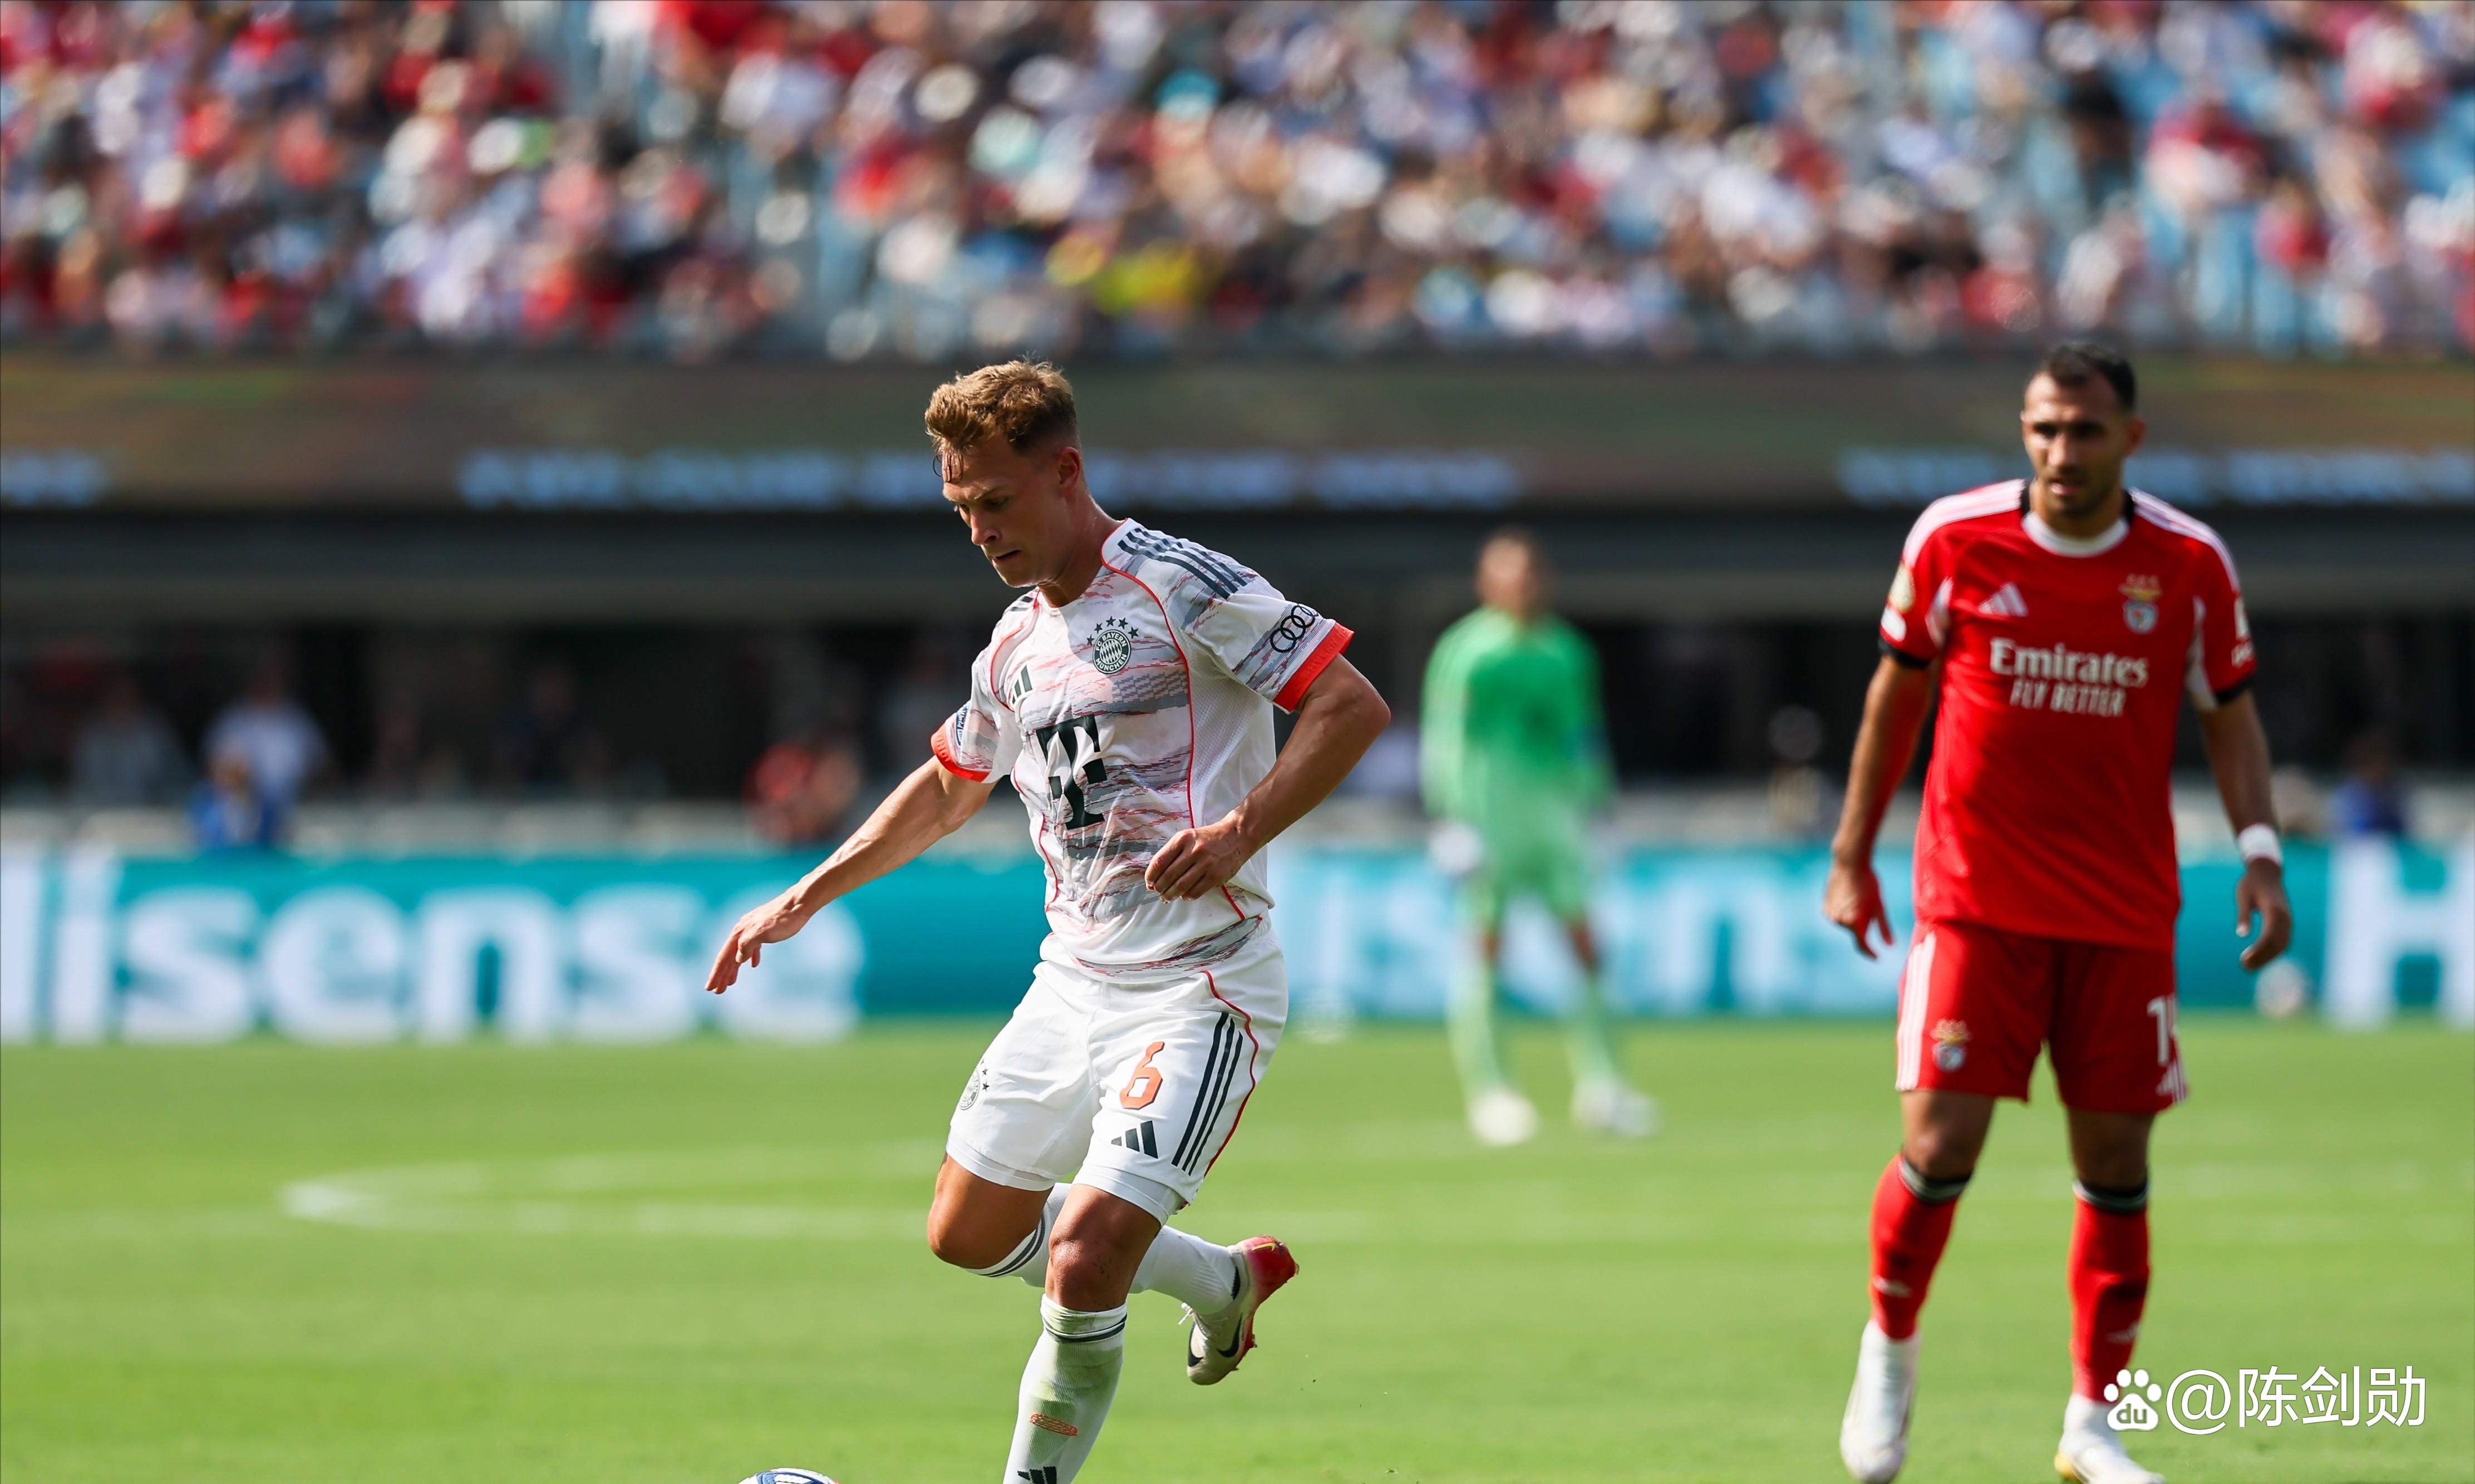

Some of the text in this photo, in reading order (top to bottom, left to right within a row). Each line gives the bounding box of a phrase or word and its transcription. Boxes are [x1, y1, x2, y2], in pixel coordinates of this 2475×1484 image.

[1095, 632, 1128, 651] FC BAYERN
[1989, 637, 2149, 688] Emirates
[2010, 677, 2125, 717] FLY BETTER
[1036, 713, 1108, 830] T
[0, 843, 865, 1043] isense
[1119, 1041, 1165, 1111] 6
